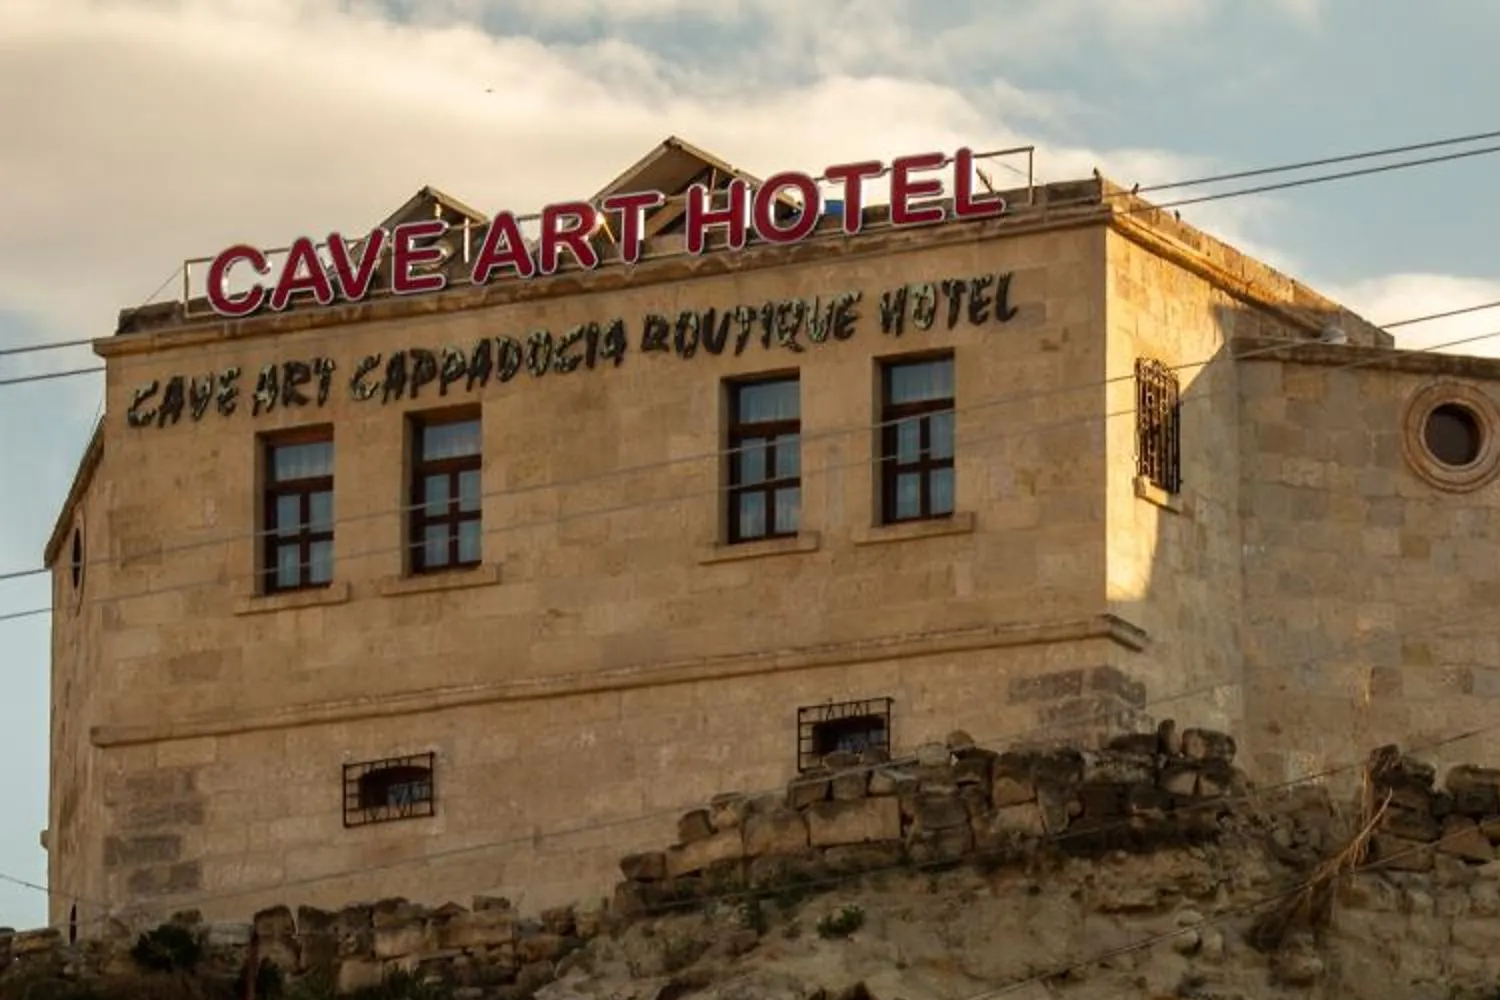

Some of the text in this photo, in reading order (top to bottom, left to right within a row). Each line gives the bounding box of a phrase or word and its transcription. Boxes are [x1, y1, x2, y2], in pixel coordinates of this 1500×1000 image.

[206, 147, 1006, 316] CAVE ART HOTEL
[127, 272, 1018, 428] CAVE ART CAPPADOCIA BOUTIQUE HOTEL
